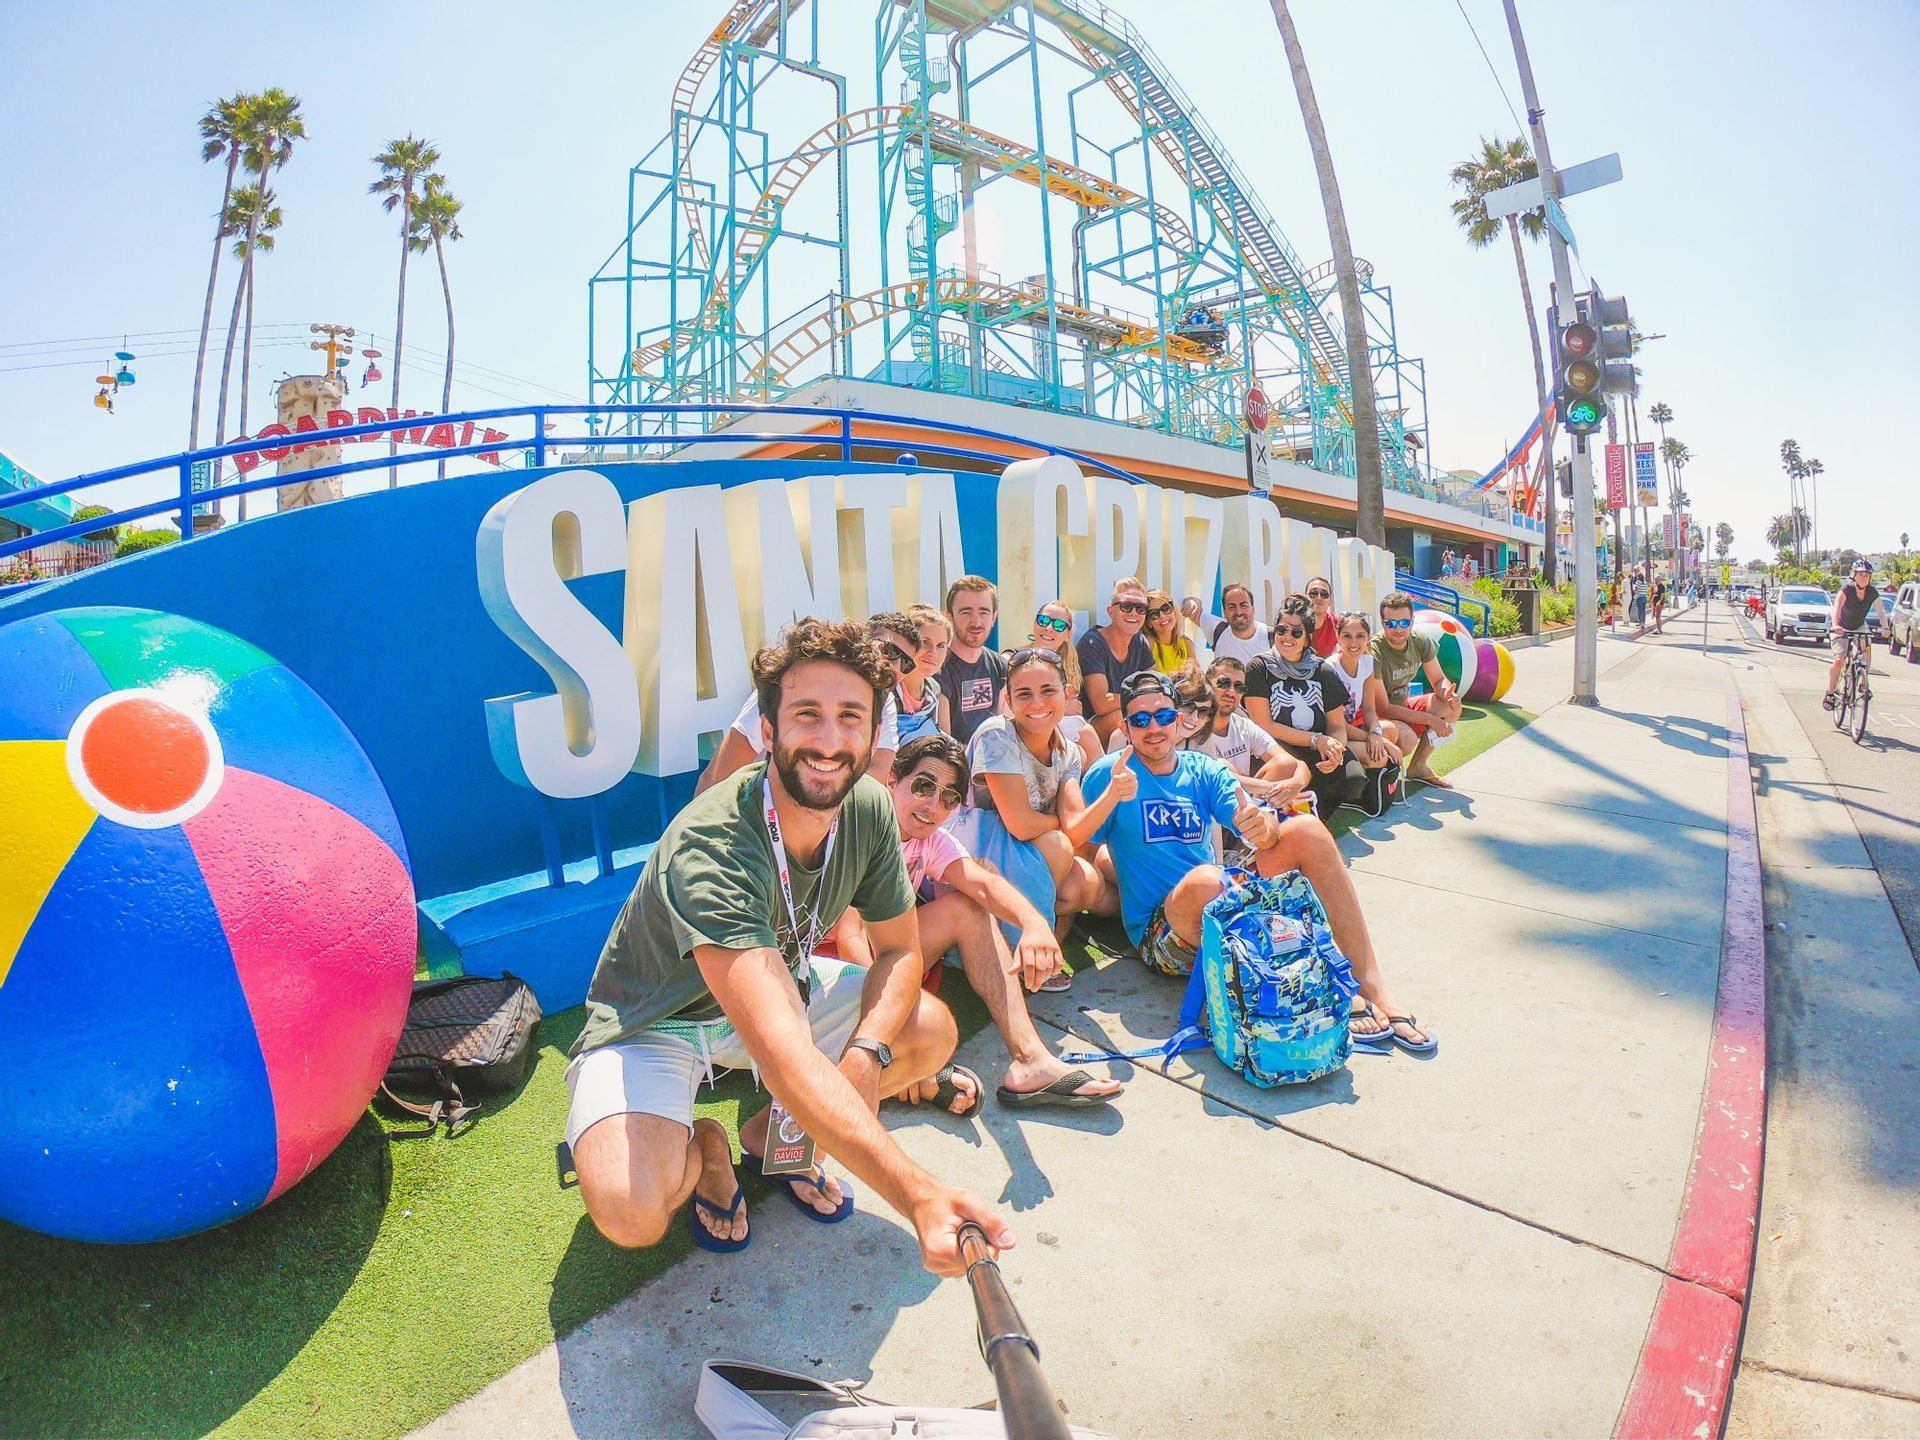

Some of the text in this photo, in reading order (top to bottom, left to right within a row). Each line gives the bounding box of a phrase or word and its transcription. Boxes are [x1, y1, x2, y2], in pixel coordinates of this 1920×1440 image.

[1249, 399, 1267, 419] STOP
[227, 407, 510, 475] BOARDWALK
[1610, 447, 1623, 504] Boardwalk
[1636, 460, 1655, 469] BEST
[1637, 481, 1657, 489] PARK
[476, 469, 967, 800] SANTA
[997, 454, 1225, 652] CRUZ
[1148, 804, 1201, 829] CRETE
[774, 1150, 805, 1160] DAVIDE
